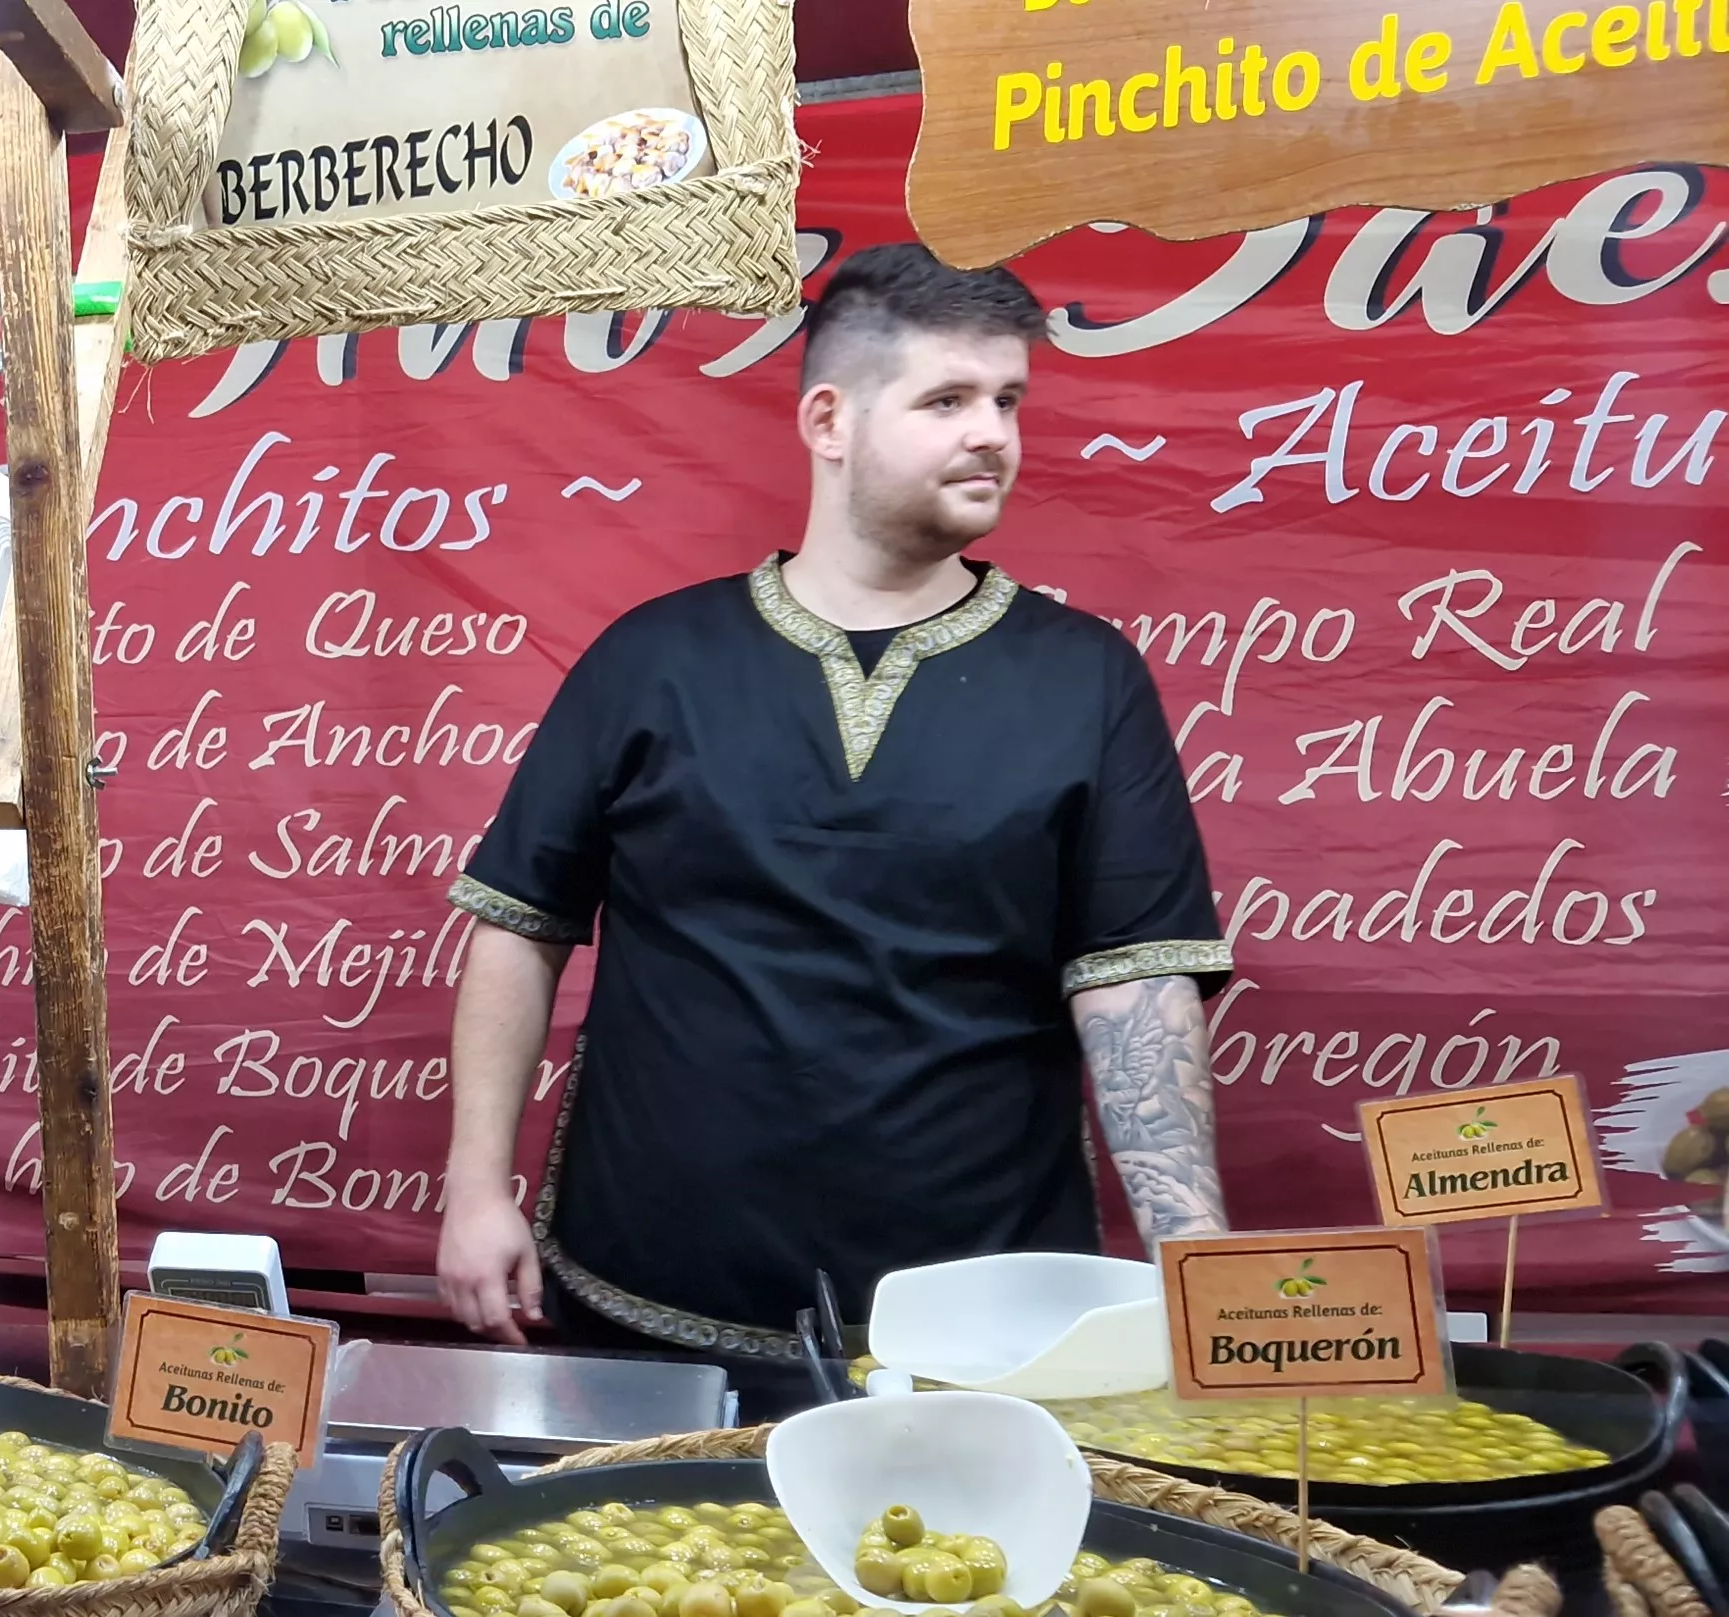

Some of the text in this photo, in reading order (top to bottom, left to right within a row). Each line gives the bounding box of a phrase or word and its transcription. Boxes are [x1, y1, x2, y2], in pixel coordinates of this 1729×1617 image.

[381, 0, 650, 57] rellenas de
[993, 37, 1321, 151] Pinchito
[1349, 13, 1451, 102] de
[217, 114, 533, 225] BERBERECHO
[1210, 371, 1728, 515] Aceitu
[86, 431, 507, 561] nchitos
[175, 581, 255, 662] de
[305, 589, 528, 660] Queso
[1098, 541, 1704, 715] mpo Real
[147, 690, 226, 771] de
[1279, 690, 1677, 804] Abuela
[143, 797, 222, 878] de
[1213, 838, 1657, 945] padedos
[128, 906, 208, 986] de
[241, 907, 477, 1030] Mejill
[110, 1015, 186, 1097] de
[214, 1029, 571, 1141] Boquen
[1208, 979, 1561, 1141] bregón
[154, 1125, 241, 1203] de
[1403, 1159, 1570, 1199] Almendra
[1411, 1137, 1544, 1162] Aceitunas Rellenas de:
[1209, 1328, 1402, 1373] Boquerón
[1218, 1303, 1382, 1320] Aceitunas Rellenas de:
[159, 1362, 285, 1393] Aceitunas Rellenas de:
[160, 1382, 273, 1429] Bonito
